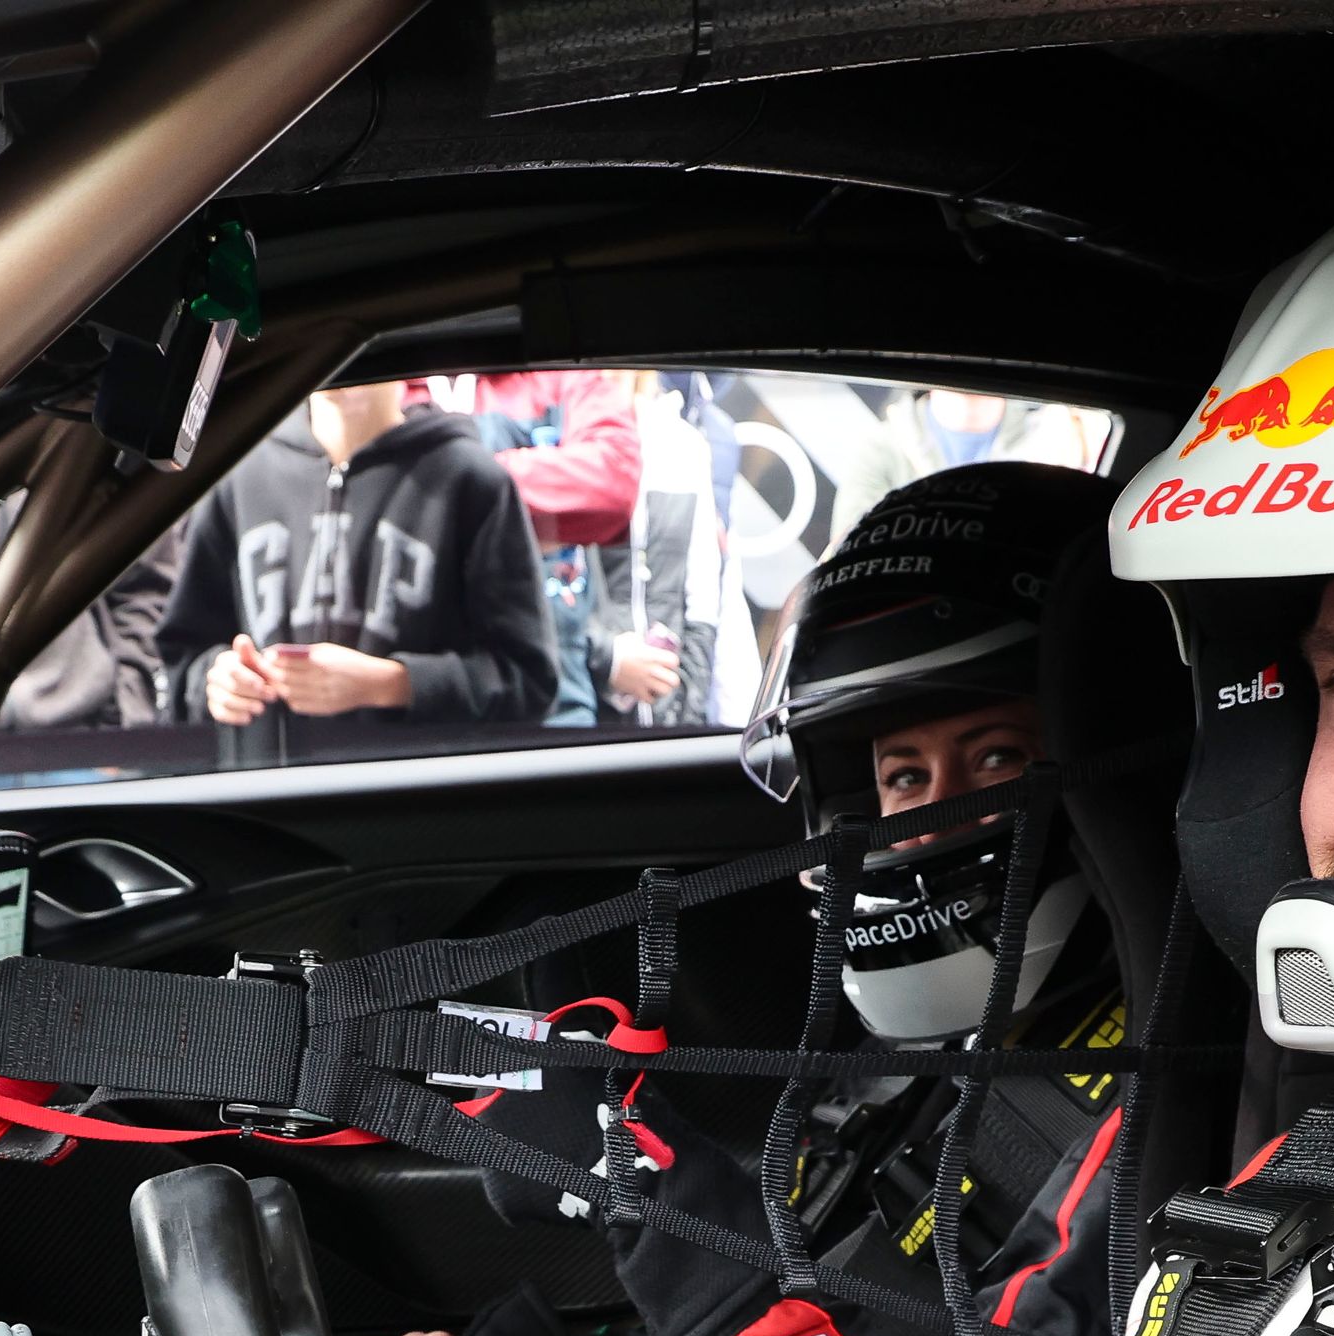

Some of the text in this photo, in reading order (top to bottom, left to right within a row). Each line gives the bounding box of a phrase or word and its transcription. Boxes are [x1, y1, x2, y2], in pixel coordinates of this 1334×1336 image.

[1128, 462, 1271, 530] Red
[235, 513, 435, 646] GAP
[807, 556, 932, 596] HAEFFLER
[844, 898, 972, 953] paceDrive
